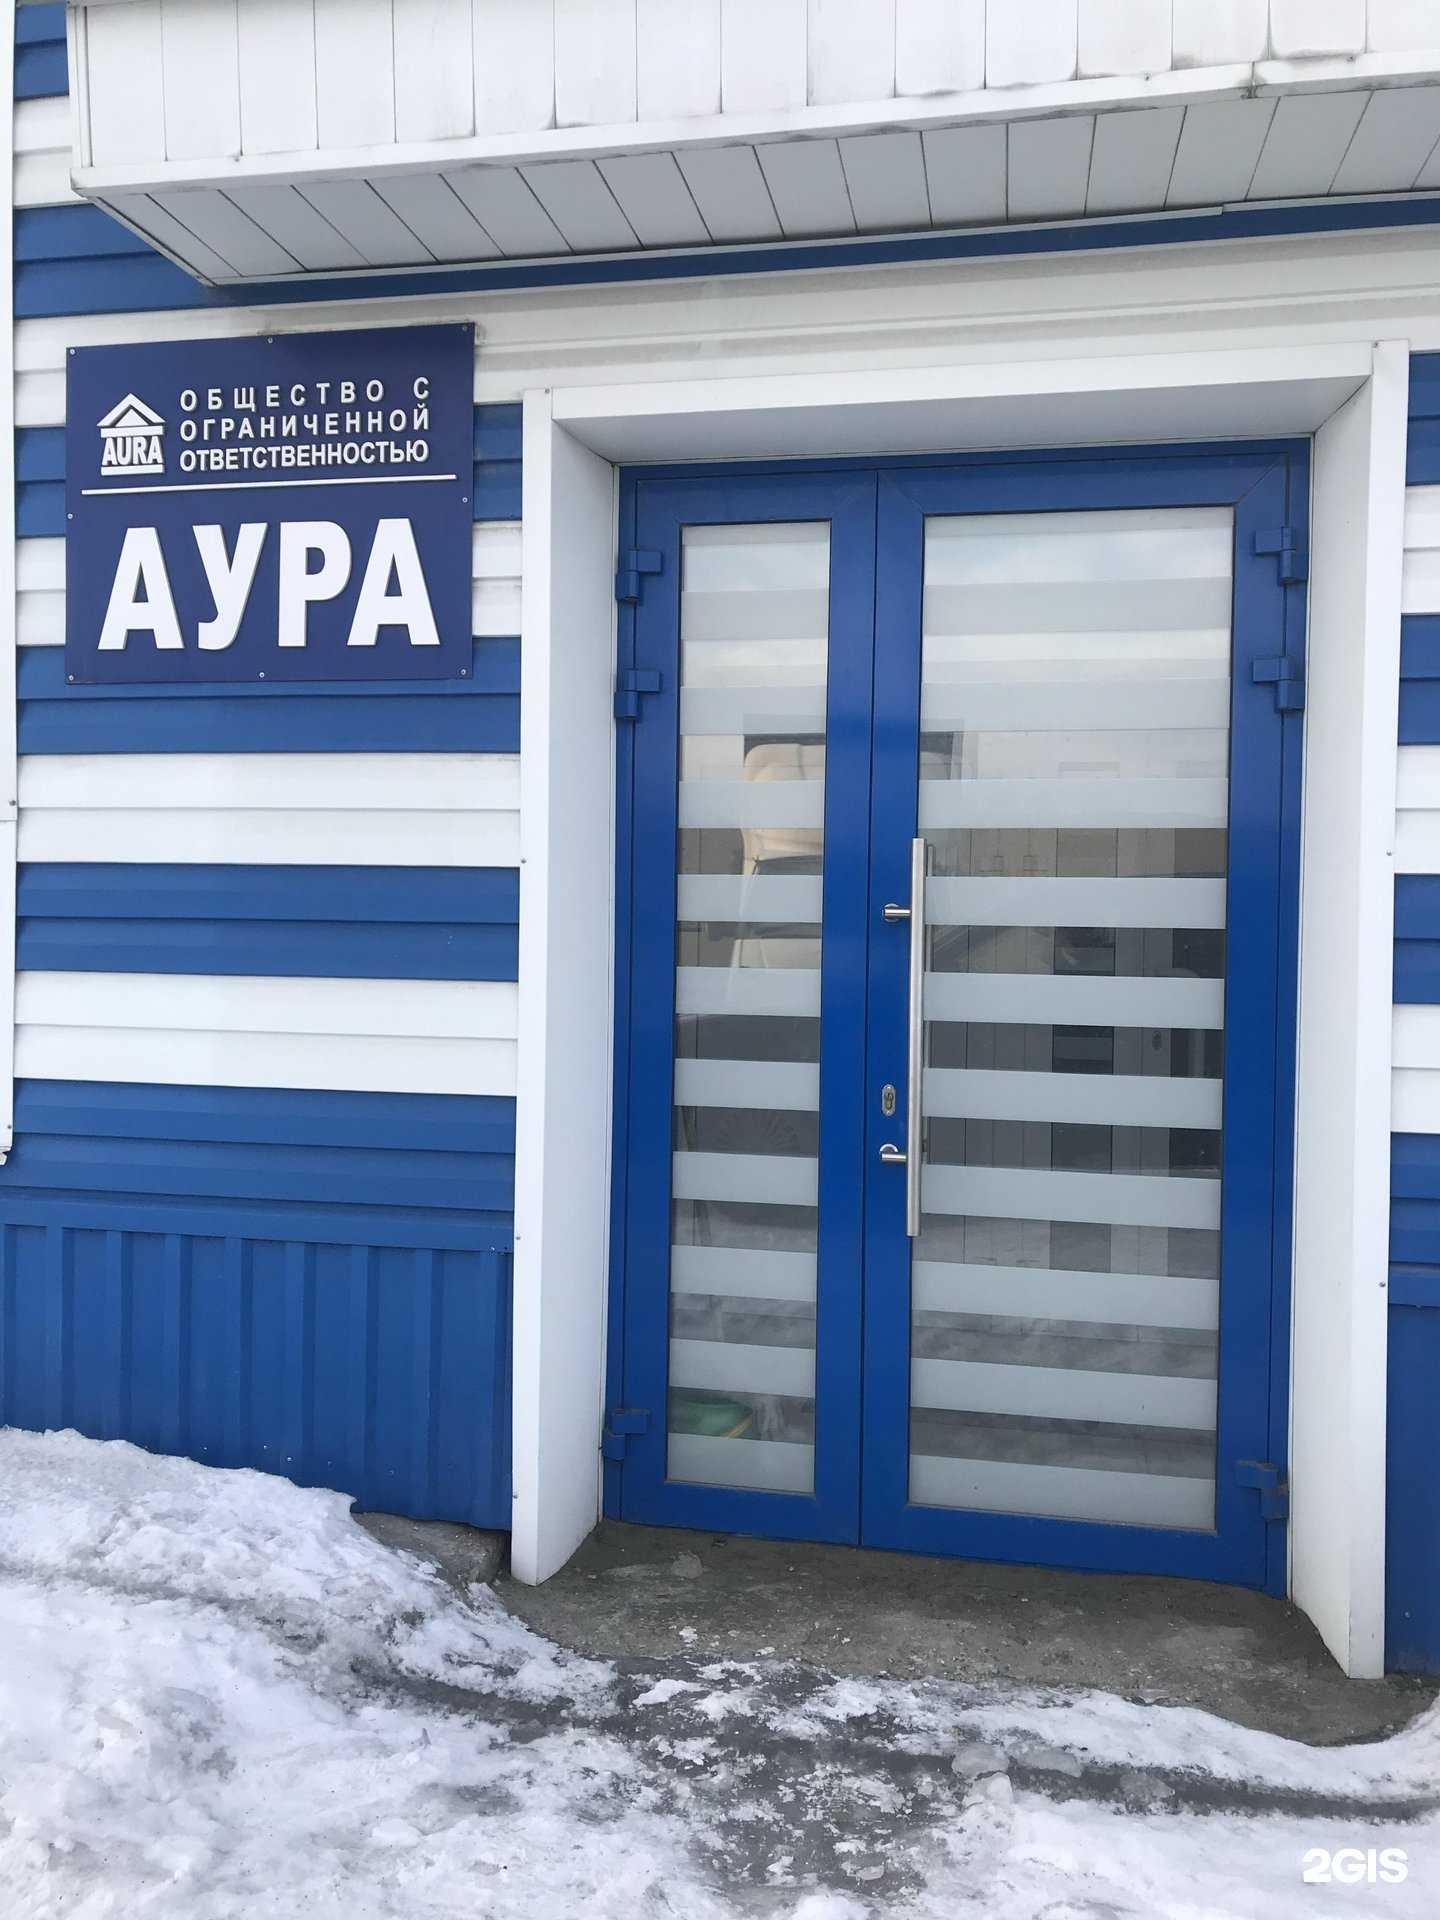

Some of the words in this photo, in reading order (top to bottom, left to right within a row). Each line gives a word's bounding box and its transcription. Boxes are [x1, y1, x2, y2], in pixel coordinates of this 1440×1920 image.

[180, 379, 384, 413] ОБЩЕСТВО
[413, 376, 430, 400] С
[180, 403, 430, 441] ОГРАНИЧЕННОЙ
[102, 436, 163, 466] AURA
[180, 440, 429, 472] ОТВЕТСТВЕННОСТЬЮ
[97, 518, 440, 651] АУРА
